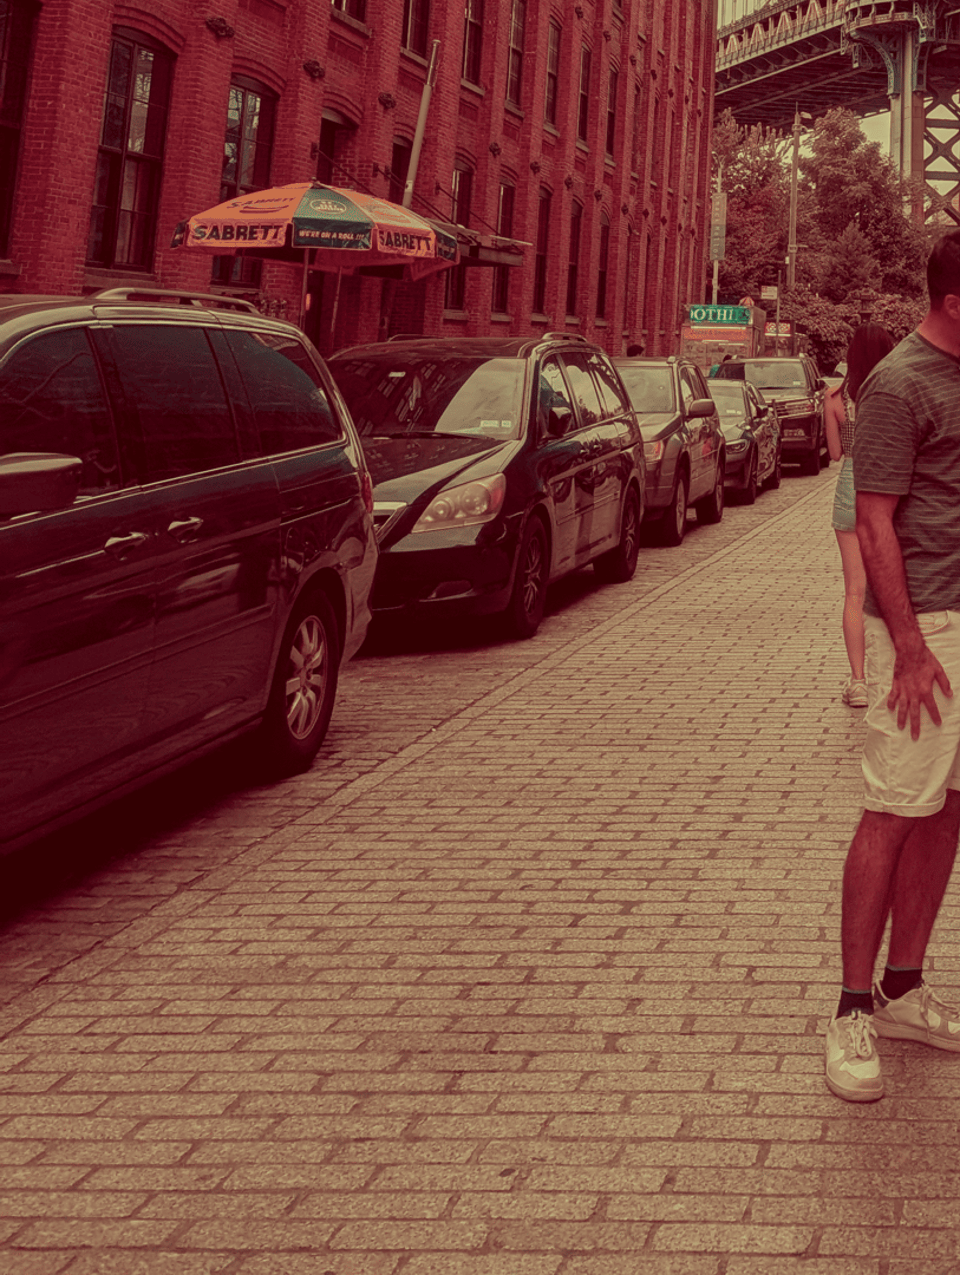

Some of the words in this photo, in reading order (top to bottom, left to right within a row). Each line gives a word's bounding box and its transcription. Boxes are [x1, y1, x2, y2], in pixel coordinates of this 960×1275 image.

[192, 225, 283, 241] SABRETT
[338, 232, 354, 240] ROLL
[379, 230, 431, 251] SABRETT
